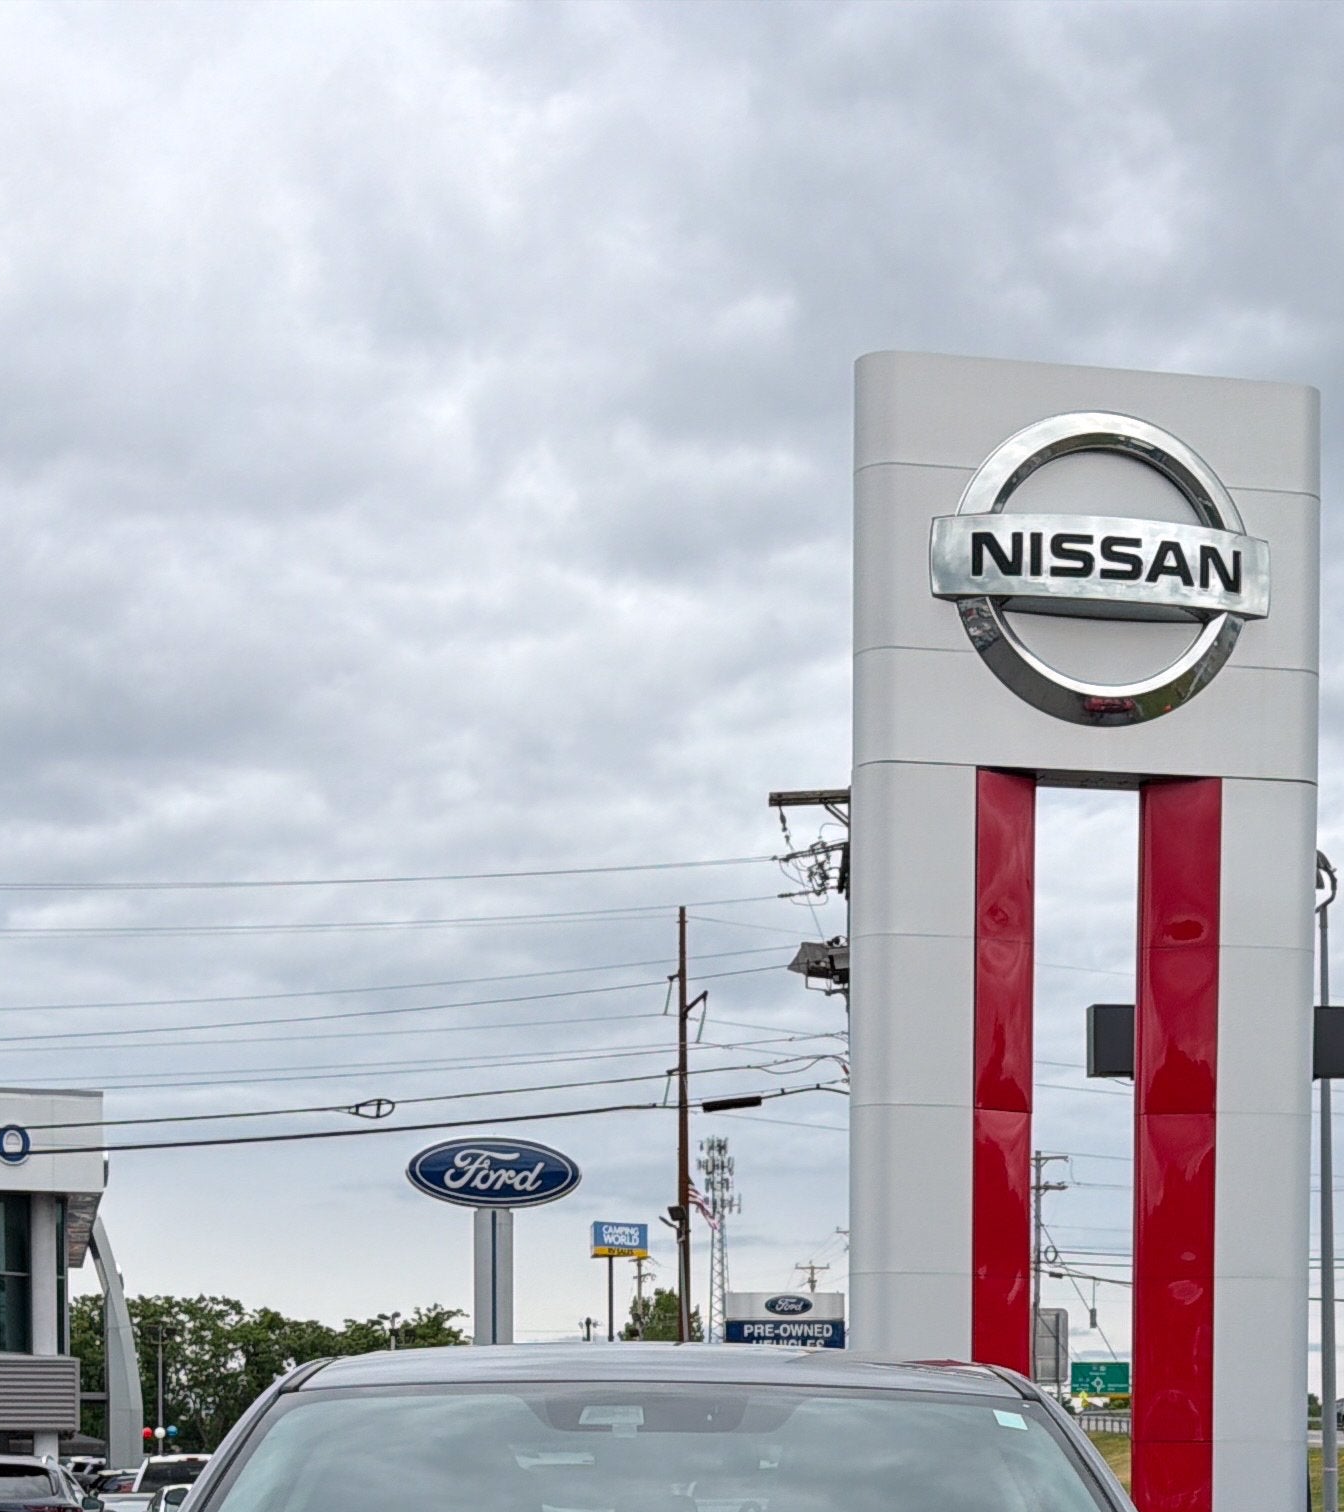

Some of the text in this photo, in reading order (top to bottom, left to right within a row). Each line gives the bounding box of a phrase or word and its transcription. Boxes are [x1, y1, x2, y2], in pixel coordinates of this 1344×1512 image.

[971, 531, 1242, 593] NISSAN
[443, 1149, 545, 1191] Ford
[603, 1233, 640, 1246] WORLD
[776, 1298, 805, 1312] Ford
[743, 1323, 833, 1337] PRE-OWNED
